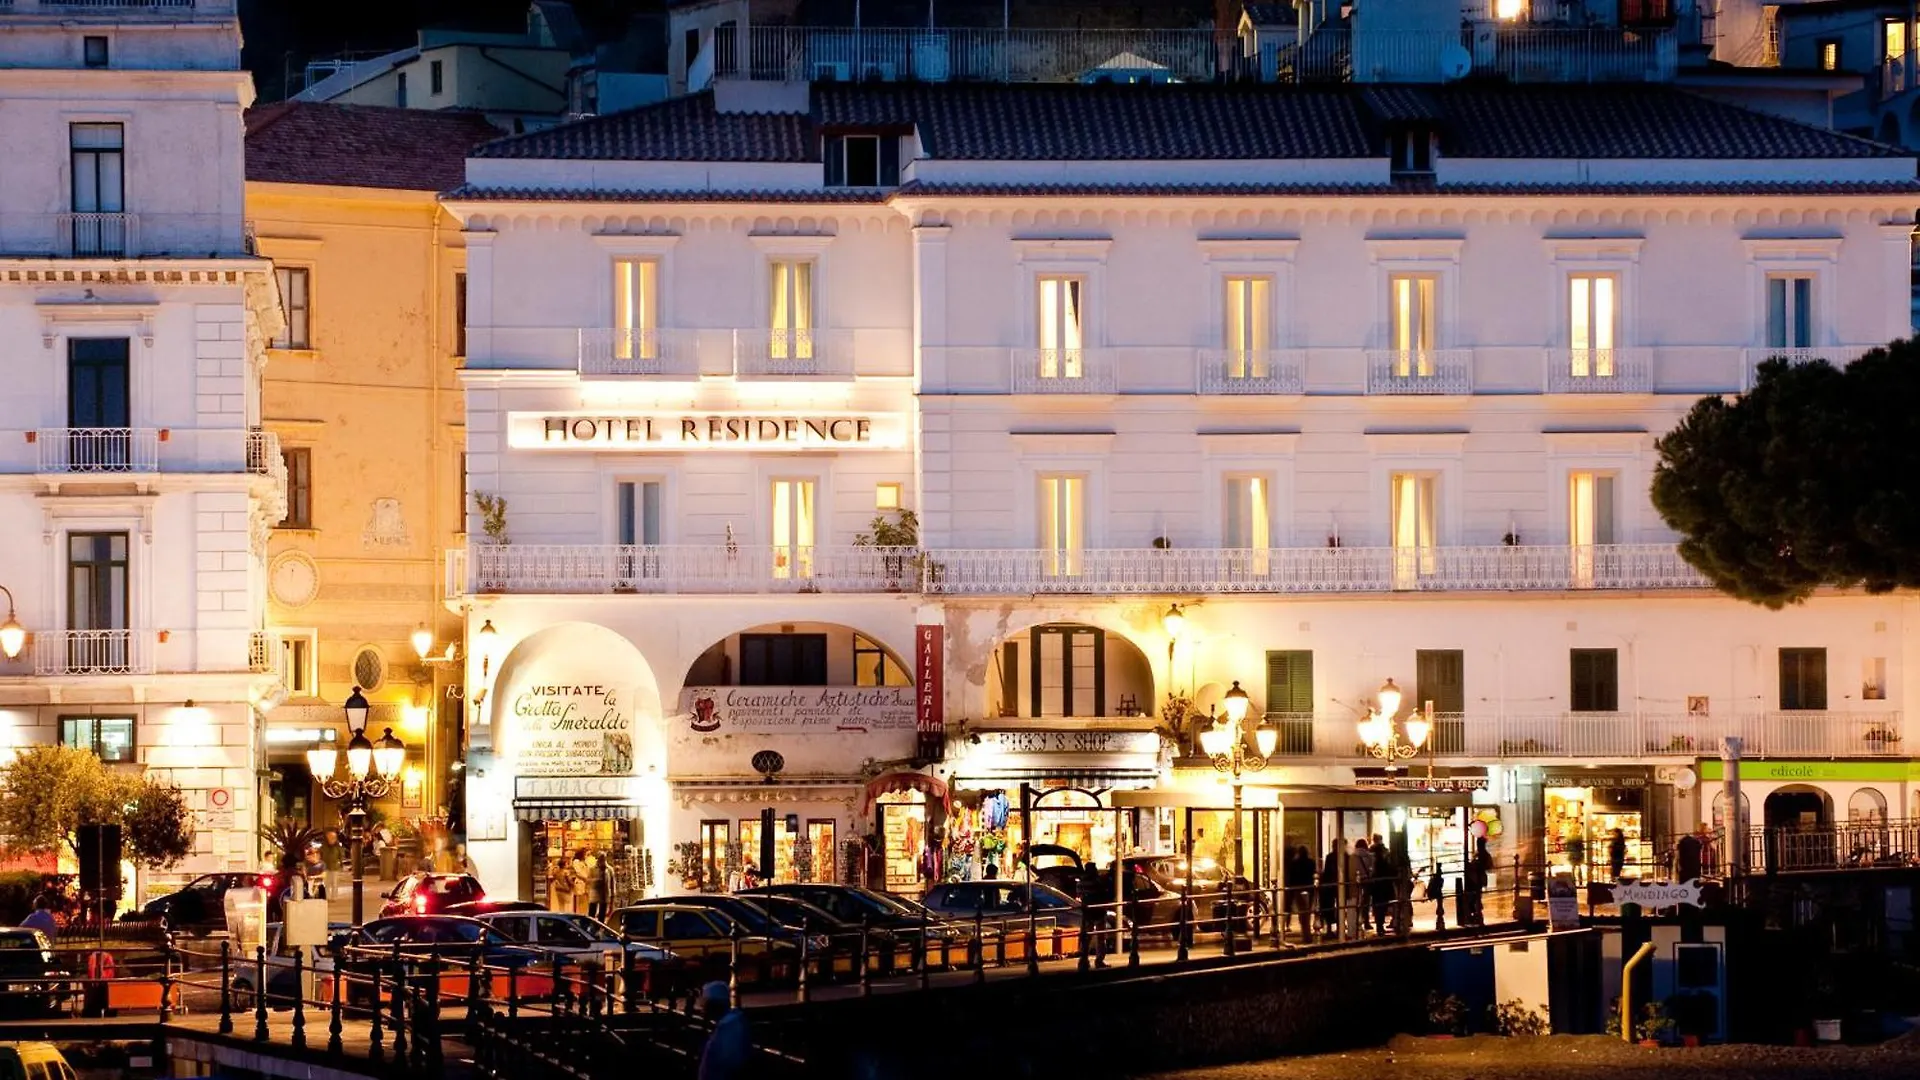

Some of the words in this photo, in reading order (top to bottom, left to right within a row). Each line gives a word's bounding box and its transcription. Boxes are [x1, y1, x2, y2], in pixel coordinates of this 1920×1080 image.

[543, 415, 660, 441] HOTEL
[680, 414, 871, 441] RESIDENCE
[515, 693, 562, 716] Grotta
[531, 685, 605, 696] VISITATE
[603, 688, 617, 706] la
[726, 688, 807, 707] Ceramiche
[816, 688, 889, 706] Artistiche
[550, 702, 629, 730] Smeraldo
[556, 740, 566, 748] AL
[1074, 732, 1111, 750] SHOP
[1458, 780, 1488, 788] FRESCA
[1621, 777, 1646, 786] LOTTO
